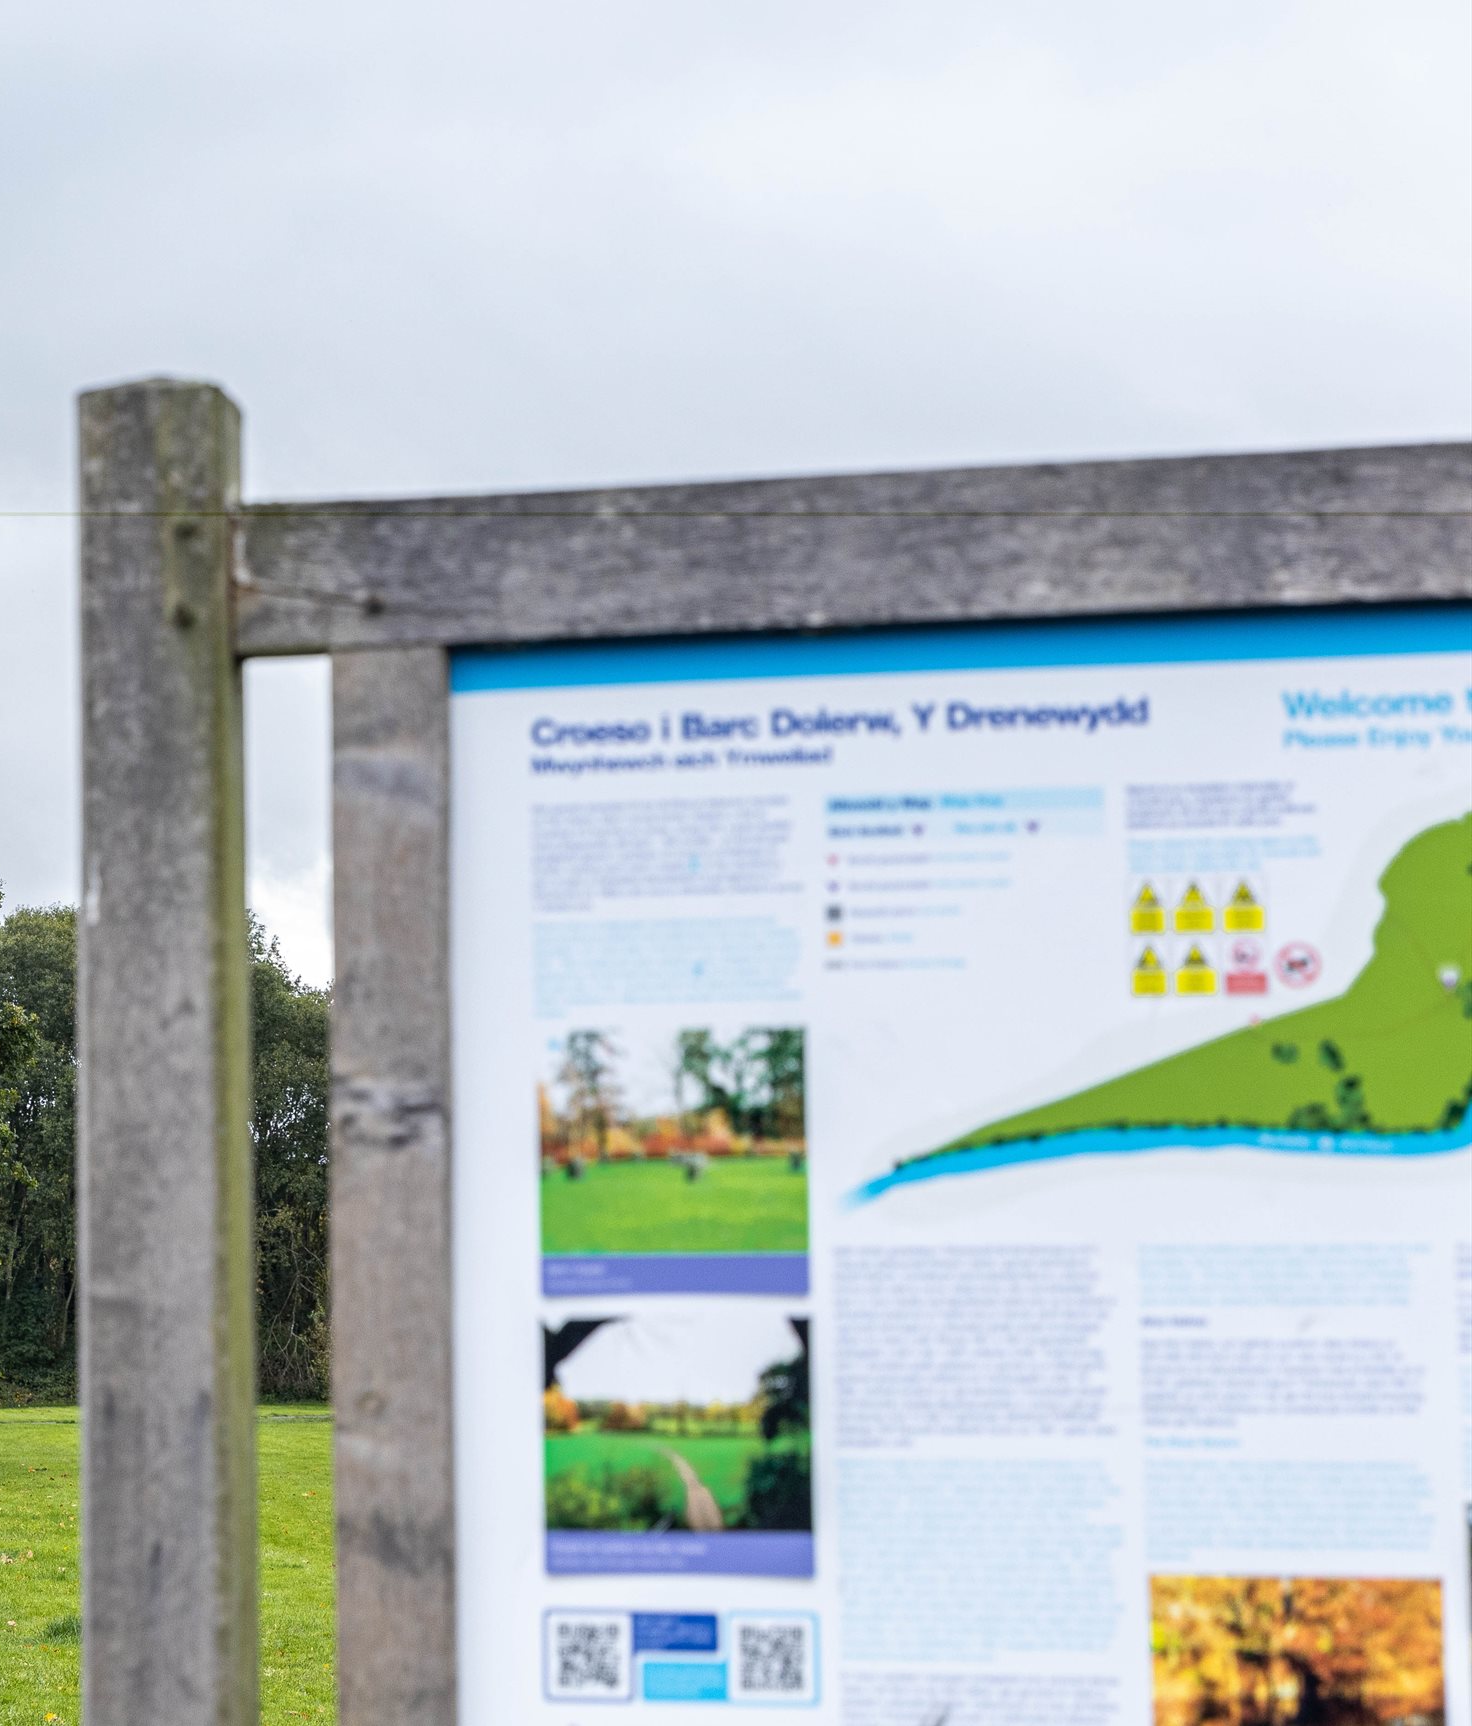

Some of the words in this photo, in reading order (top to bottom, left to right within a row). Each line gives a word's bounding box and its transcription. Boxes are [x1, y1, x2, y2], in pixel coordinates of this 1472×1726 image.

[531, 717, 651, 747] Croeso
[661, 712, 671, 742] i
[682, 711, 759, 740] Barc
[910, 700, 935, 731] Y
[946, 693, 1149, 734] Drenewydd
[1280, 688, 1454, 719] Welcome
